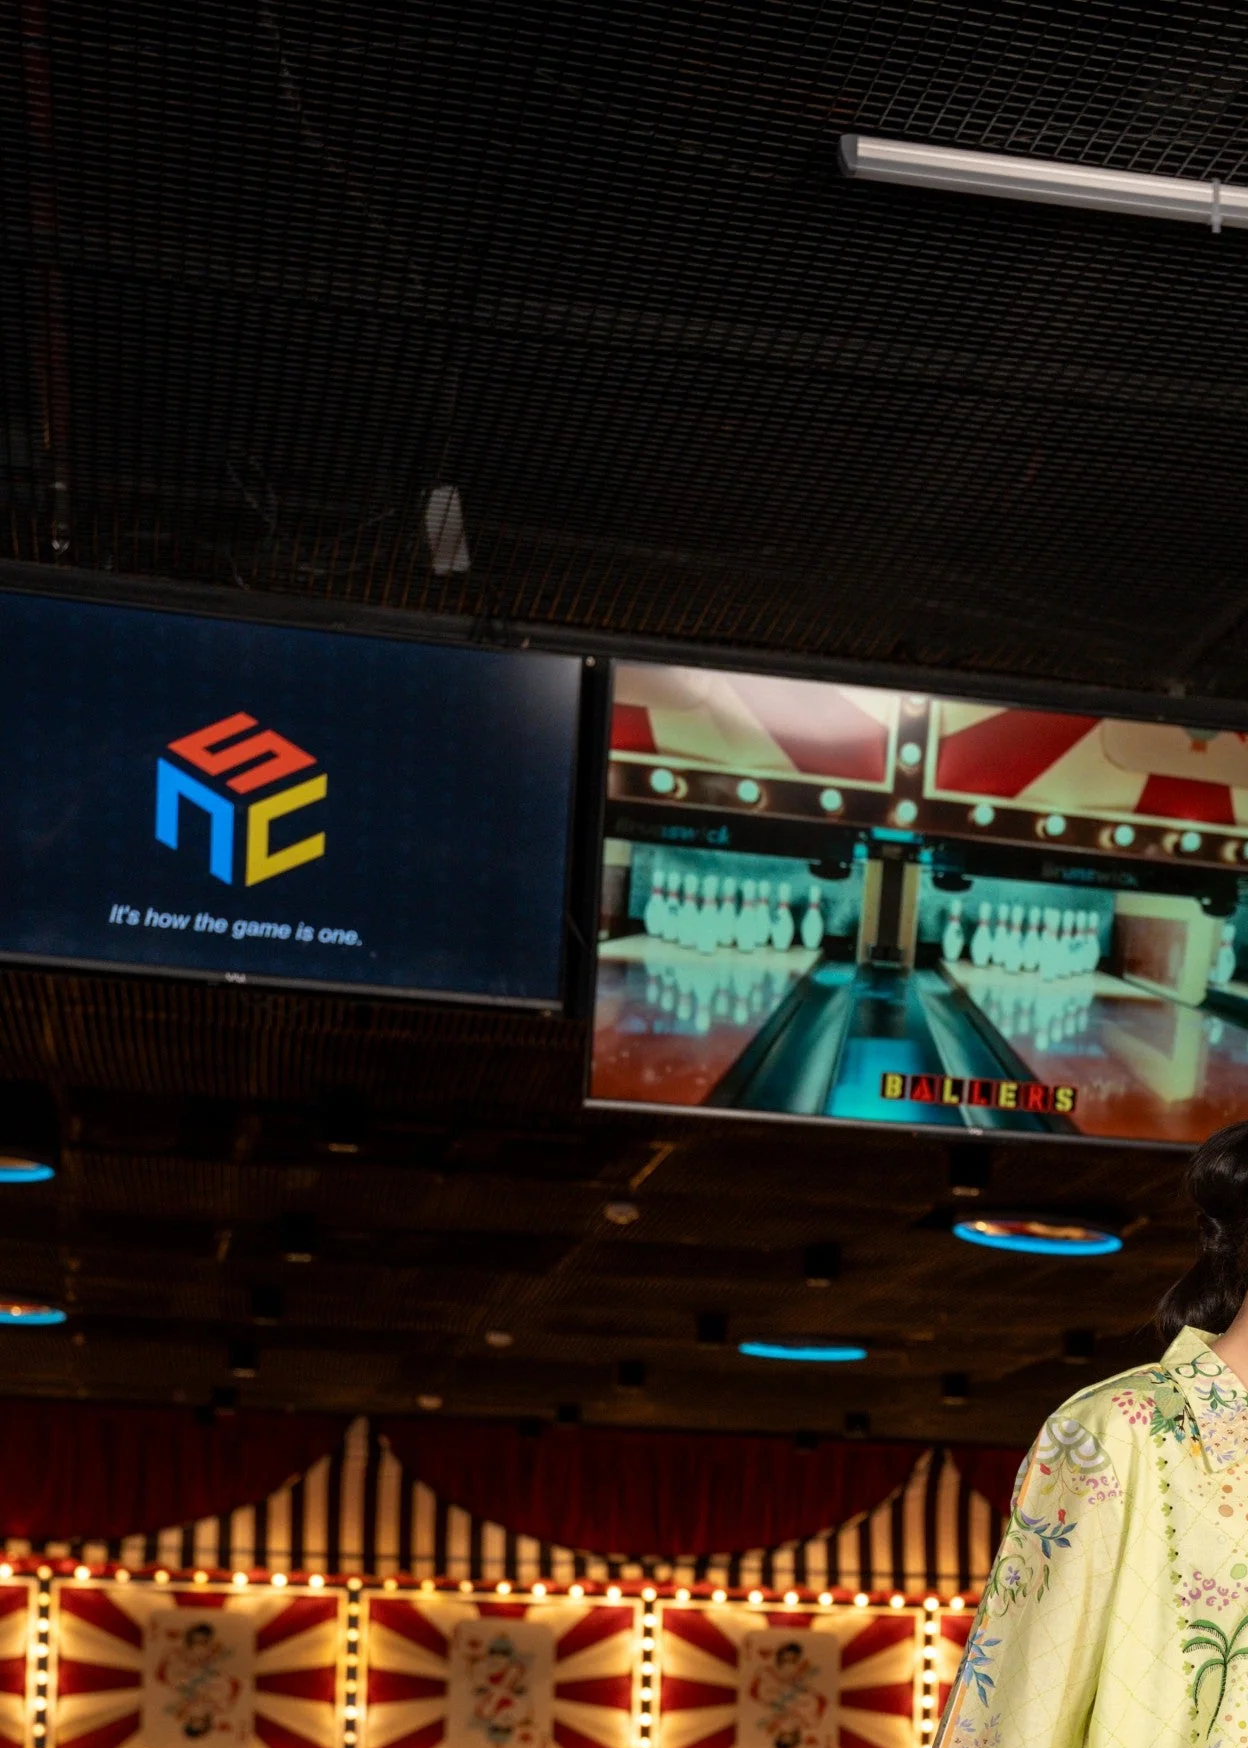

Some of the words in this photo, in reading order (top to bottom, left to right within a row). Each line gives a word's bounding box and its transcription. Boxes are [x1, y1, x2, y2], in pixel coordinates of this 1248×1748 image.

[109, 904, 140, 926] It's
[144, 908, 191, 930] how
[194, 912, 228, 934] the
[232, 919, 291, 940] game
[295, 921, 314, 942] is
[318, 927, 362, 946] one.
[884, 1073, 1075, 1113] BALLERS
